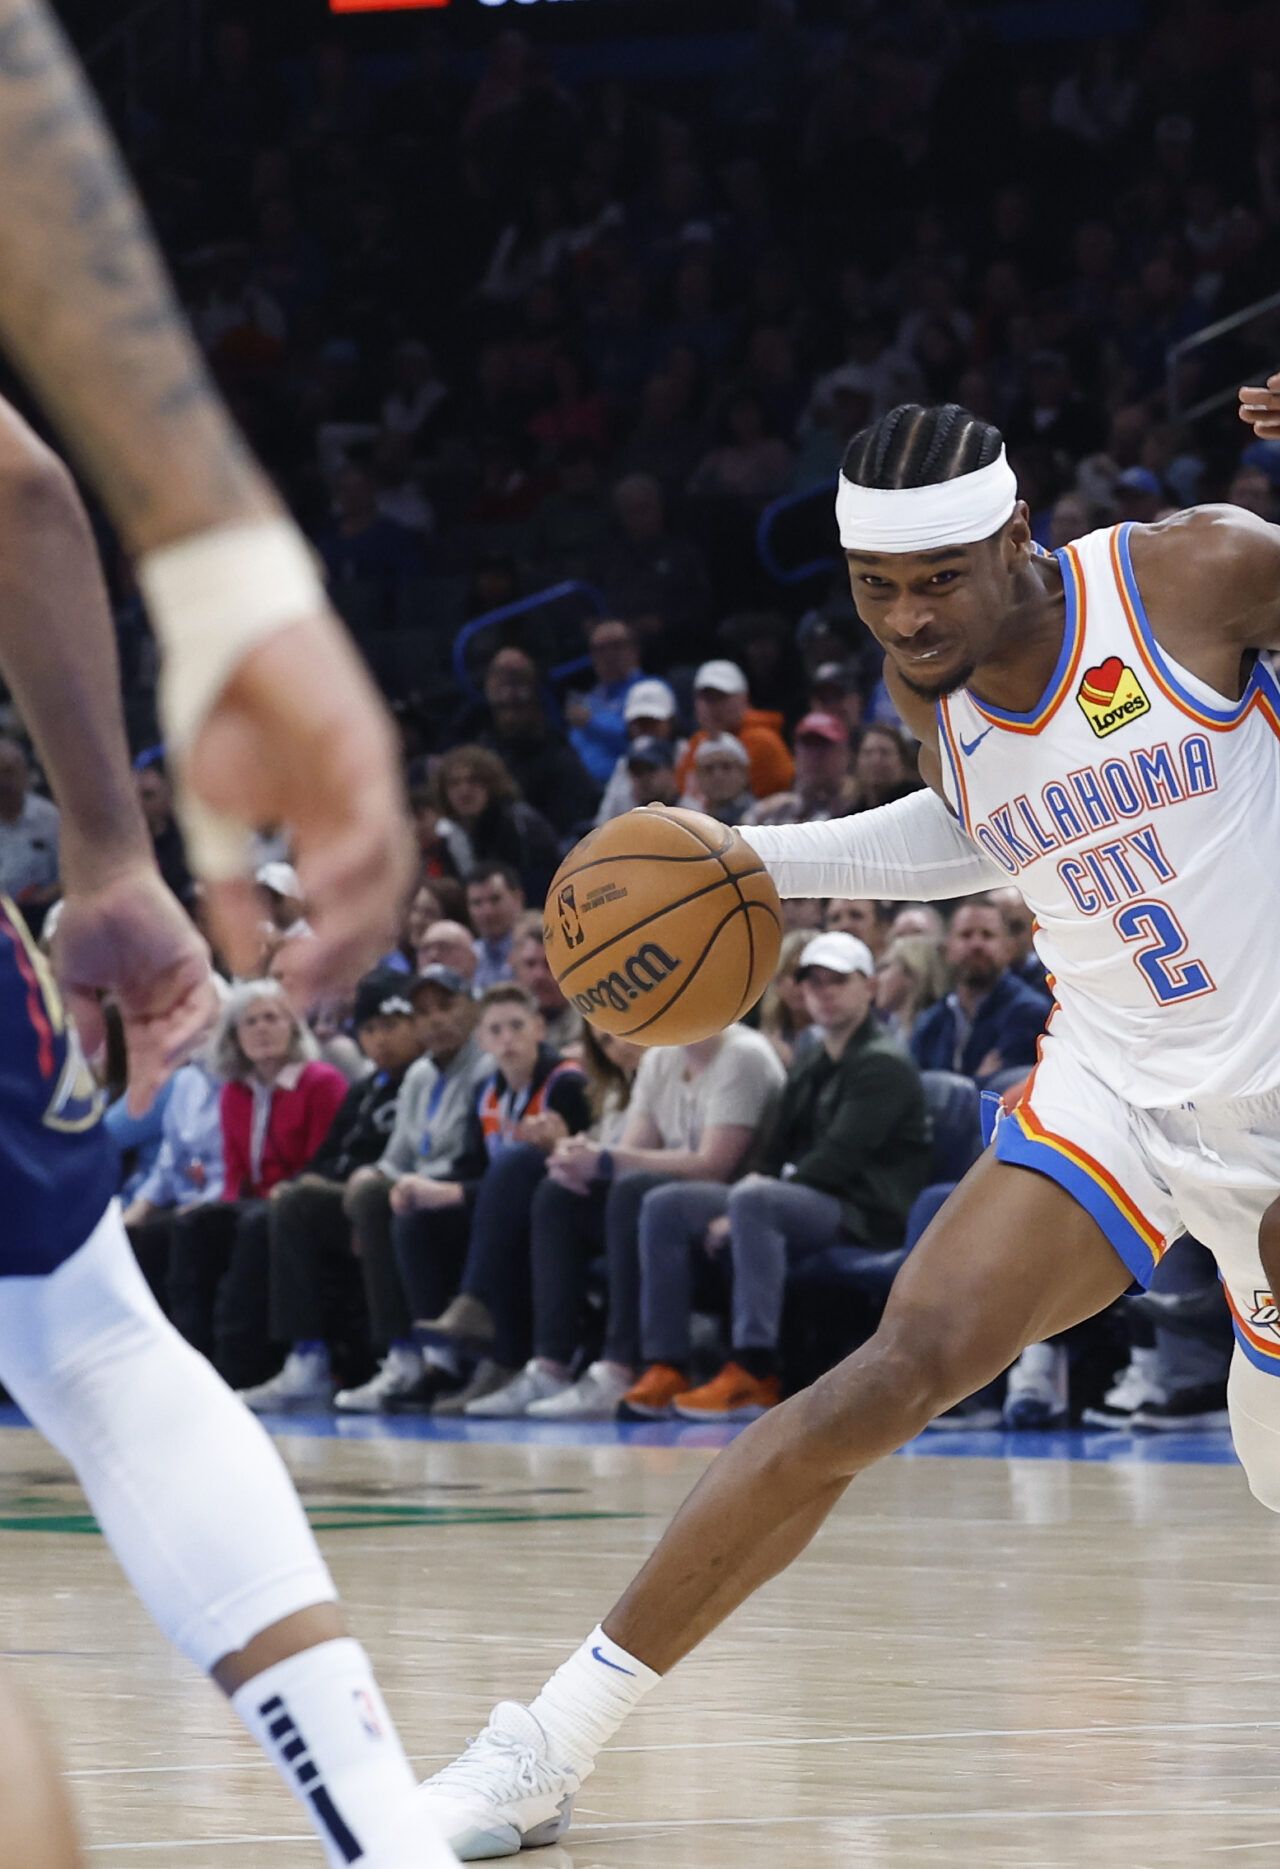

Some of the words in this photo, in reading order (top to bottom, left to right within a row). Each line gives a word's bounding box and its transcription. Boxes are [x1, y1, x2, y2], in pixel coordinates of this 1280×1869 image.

[975, 733, 1218, 875] OKLAHOMA
[1058, 824, 1176, 916] CITY
[1112, 898, 1217, 1006] 2
